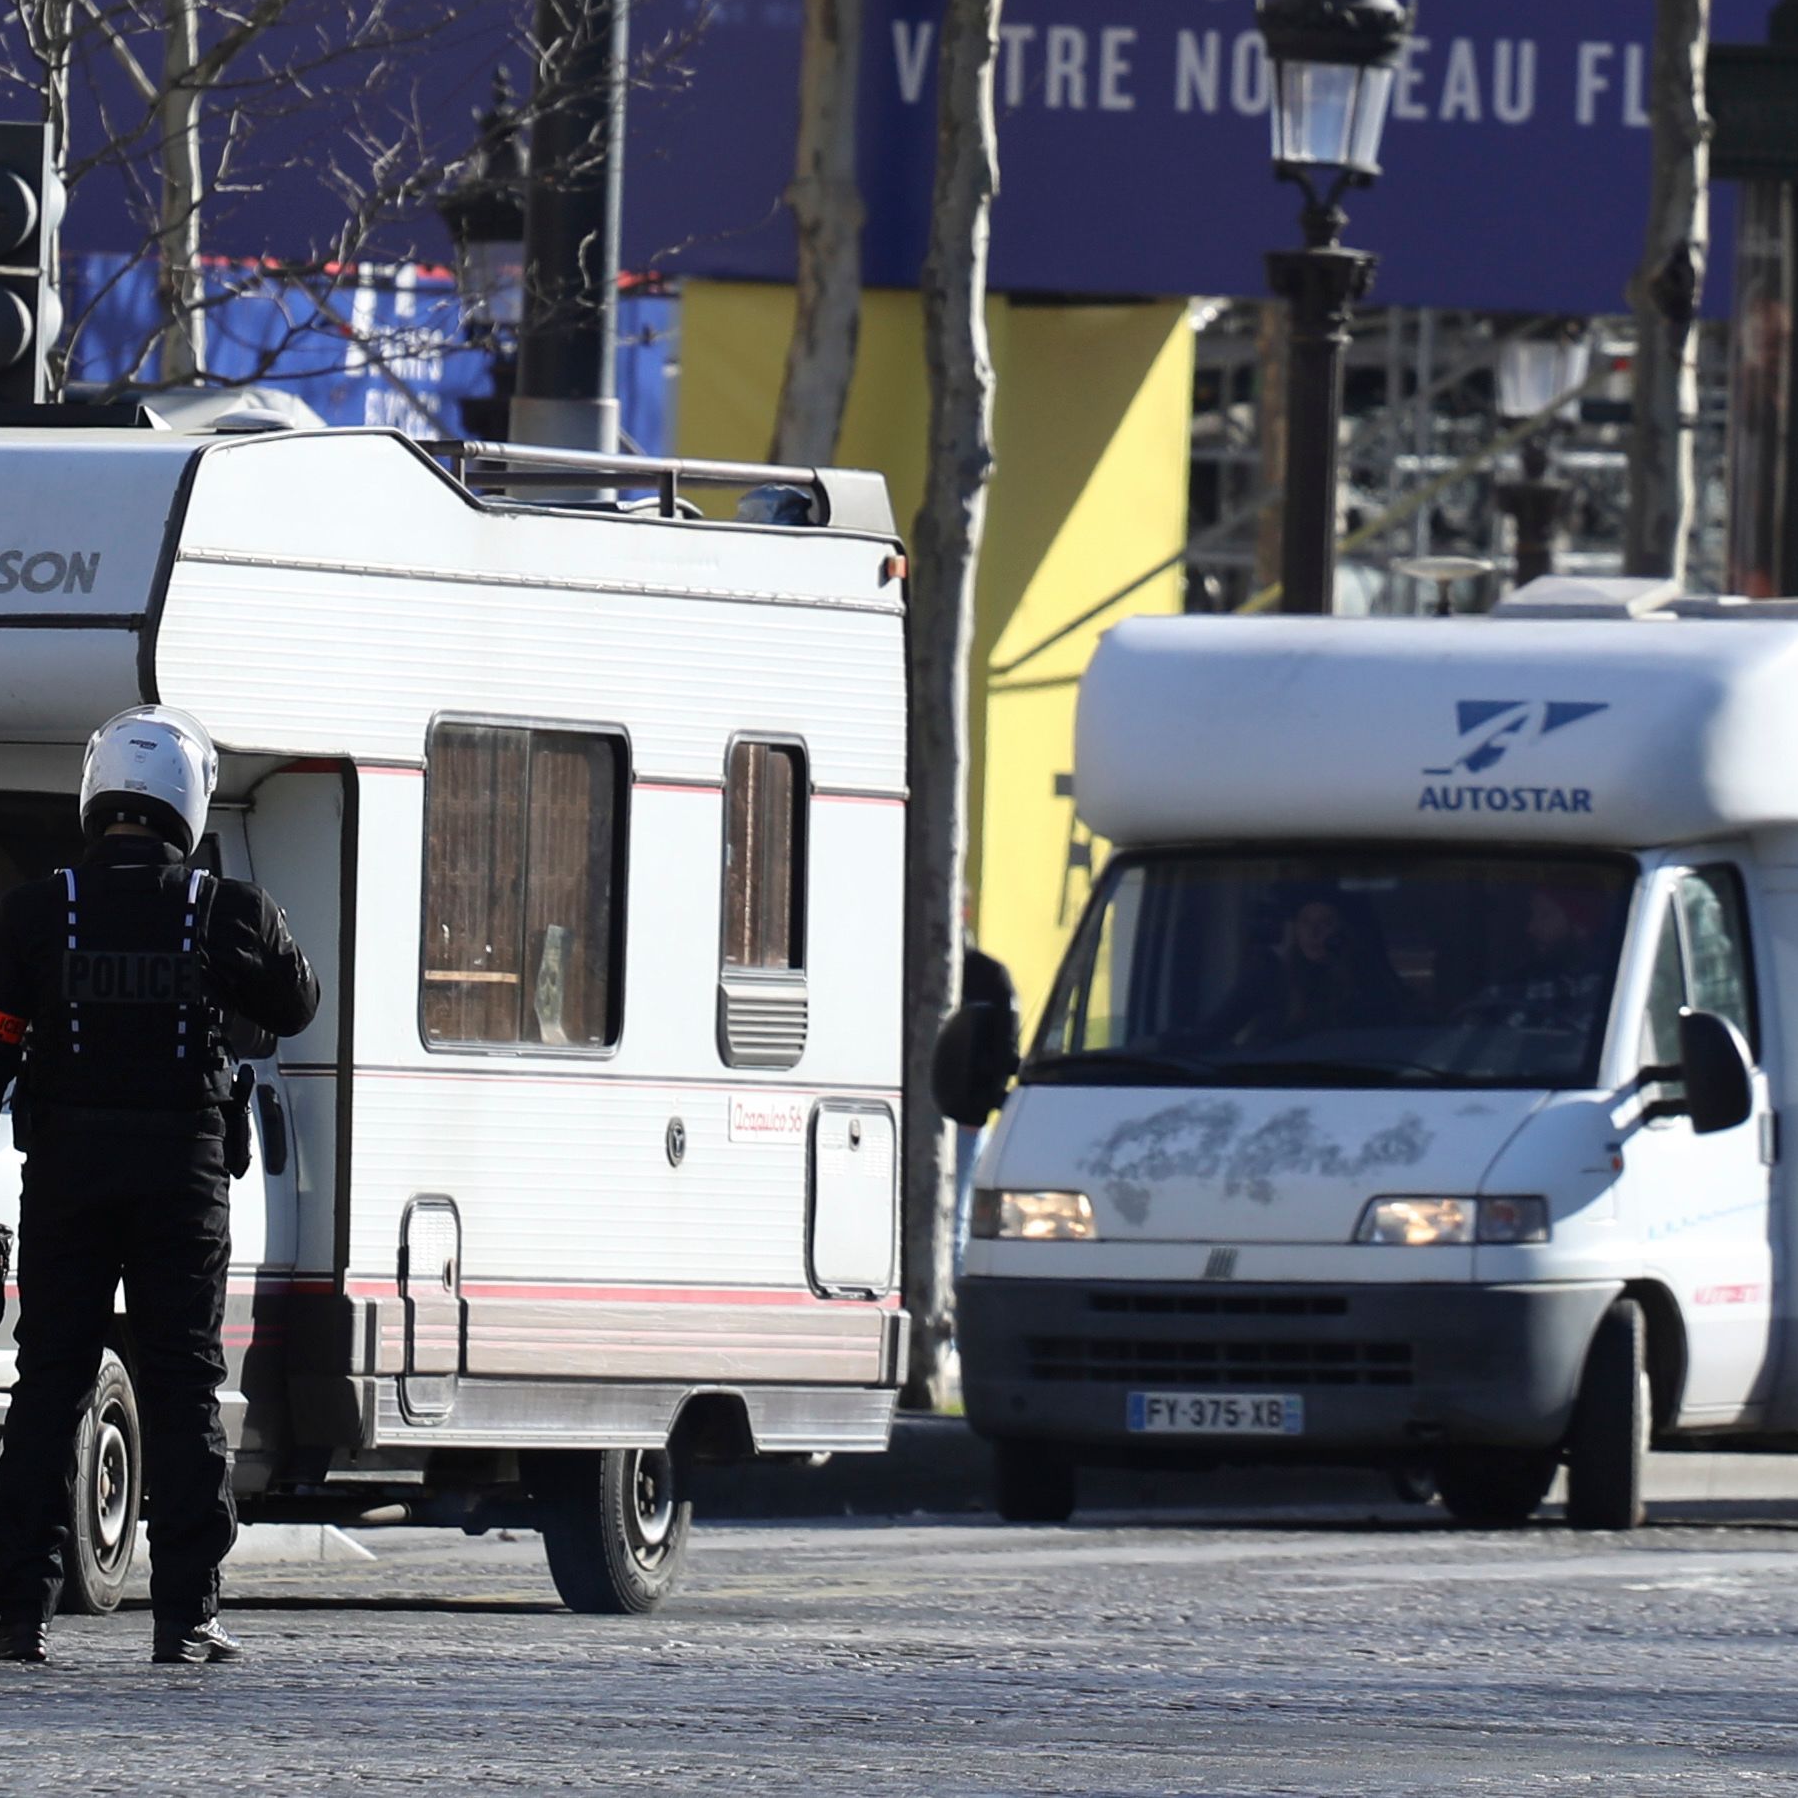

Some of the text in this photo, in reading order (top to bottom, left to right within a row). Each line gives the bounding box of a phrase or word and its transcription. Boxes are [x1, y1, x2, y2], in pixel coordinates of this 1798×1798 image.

[891, 17, 1138, 113] VTRE
[1174, 28, 1540, 125] NOEAU
[1418, 785, 1594, 813] AUTOSTAR
[68, 954, 194, 1000] POLICE
[1146, 1398, 1283, 1428] FY-375-XB
